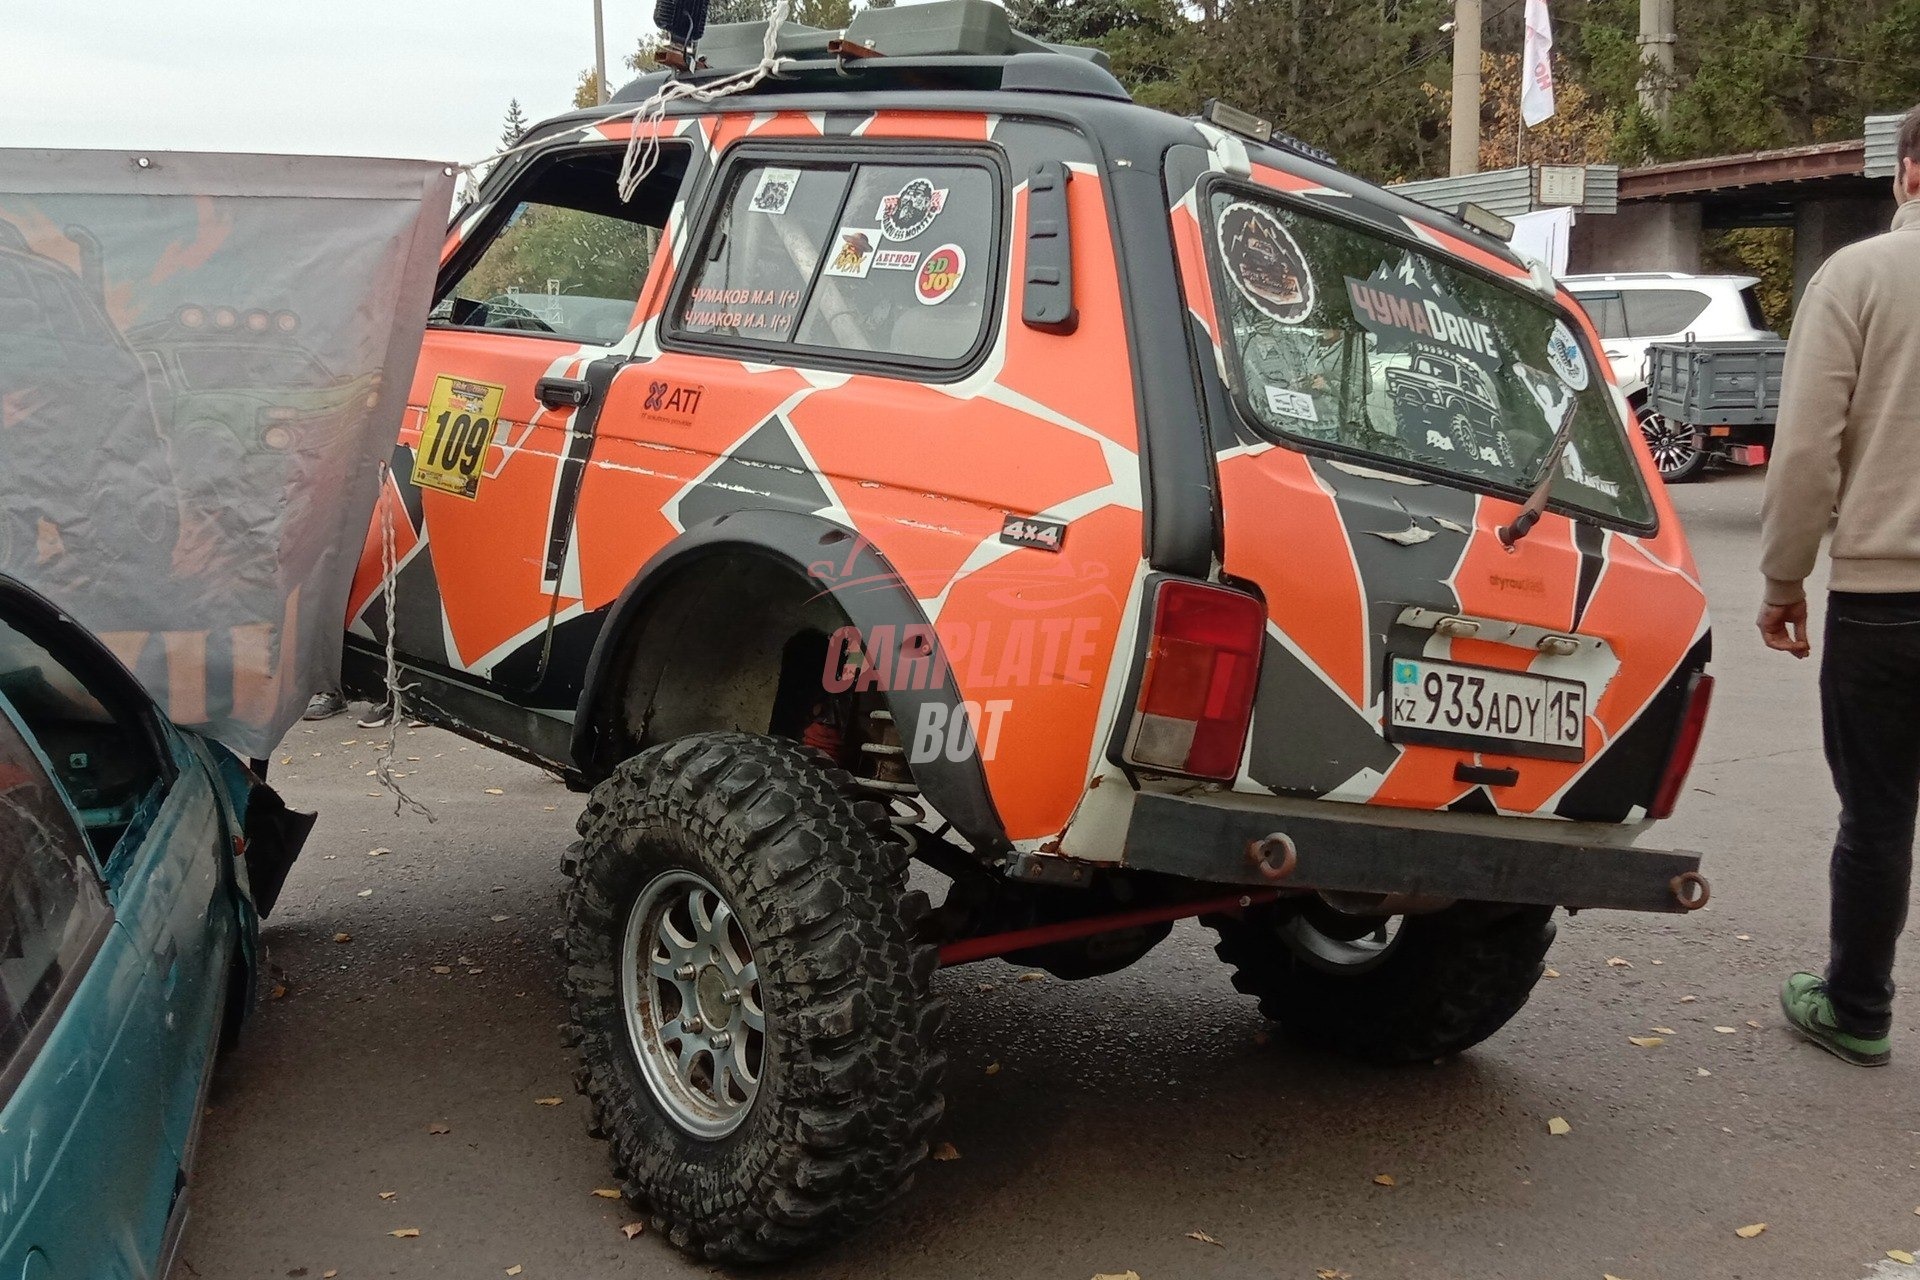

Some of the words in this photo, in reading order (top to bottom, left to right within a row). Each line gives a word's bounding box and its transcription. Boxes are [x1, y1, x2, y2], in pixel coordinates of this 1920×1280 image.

[924, 257, 949, 274] 3D
[922, 272, 960, 290] JOY
[691, 288, 750, 304] ЧУМАКОВ
[685, 310, 742, 327] ЧУМАКОВ
[743, 313, 767, 328] И.А.
[664, 388, 702, 414] ATI
[427, 410, 490, 476] 109
[1394, 698, 1417, 722] KZ
